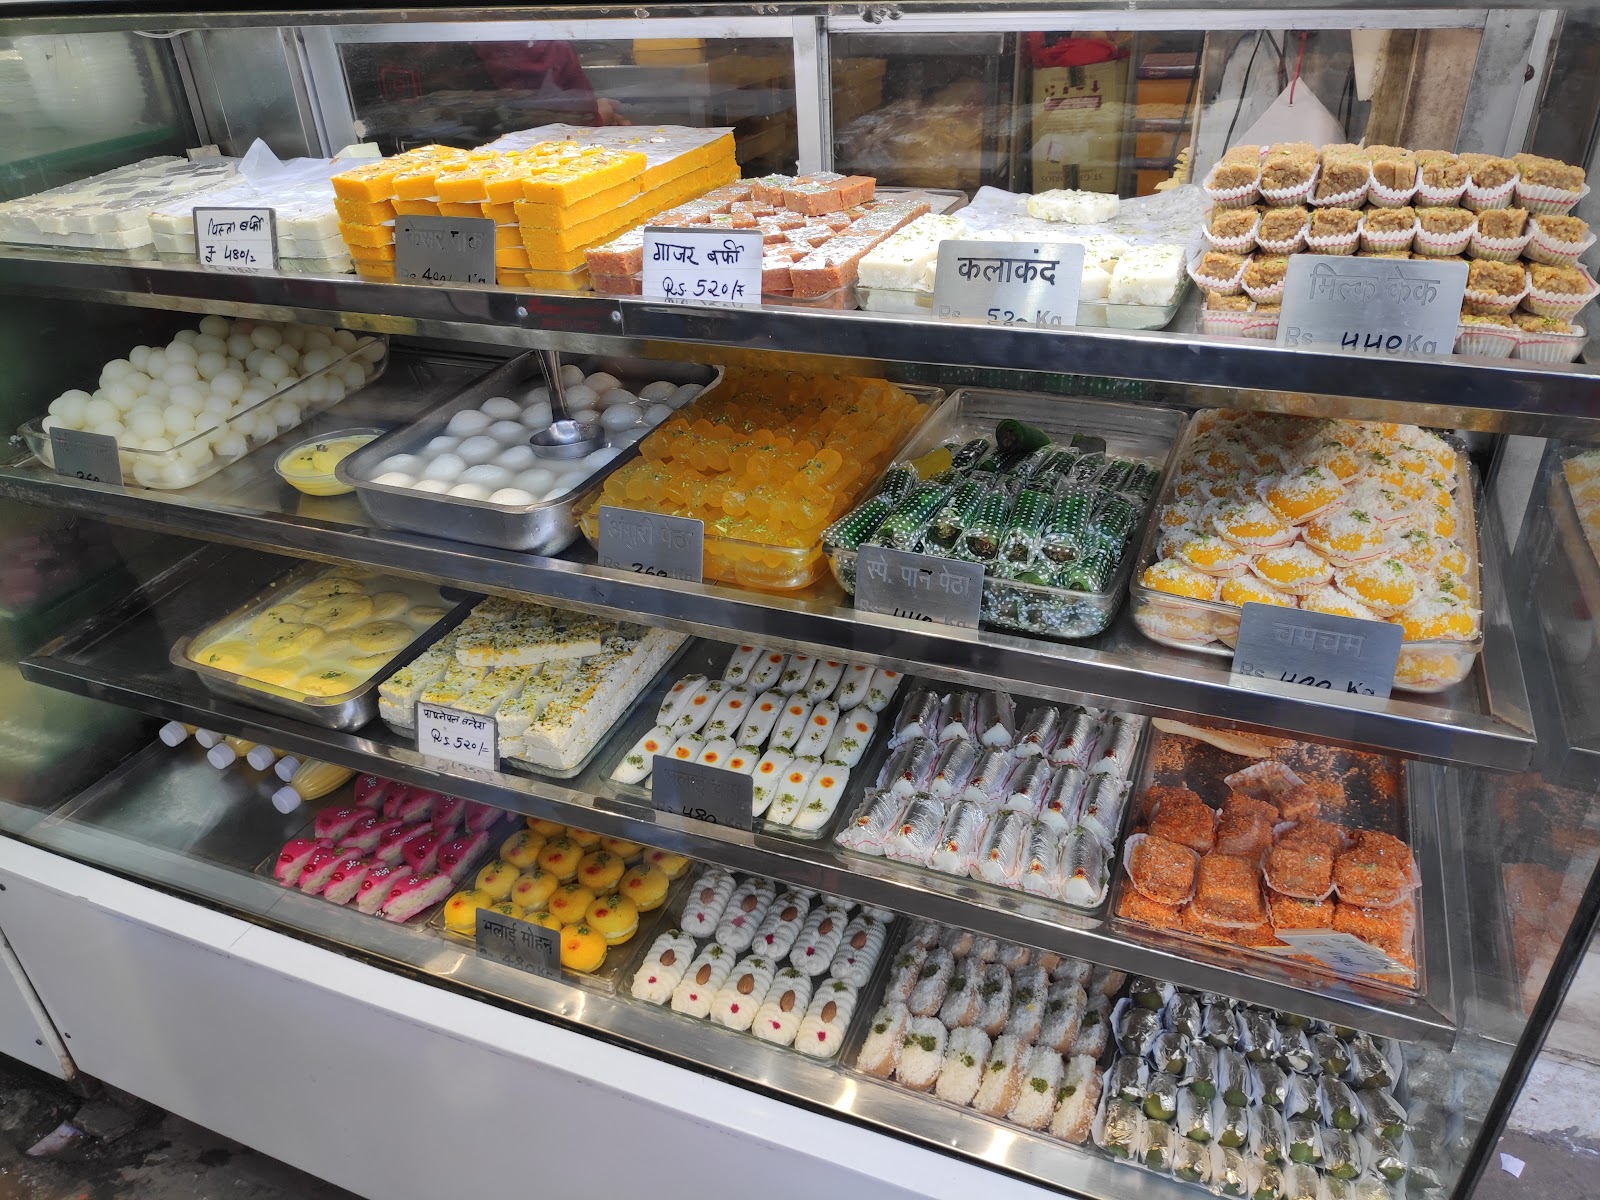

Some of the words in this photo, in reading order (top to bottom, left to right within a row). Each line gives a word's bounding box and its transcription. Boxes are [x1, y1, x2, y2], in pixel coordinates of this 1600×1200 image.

[653, 242, 700, 266] गाजर
[707, 239, 745, 266] बर्फी
[957, 248, 1061, 286] कलाकंद
[1308, 262, 1379, 302] मिल्क
[1387, 265, 1441, 306] केक
[1284, 326, 1314, 349] Rs
[900, 564, 933, 590] पान
[1272, 622, 1368, 659] चमचम
[482, 919, 517, 947] मलाई
[520, 926, 554, 955] मोहन
